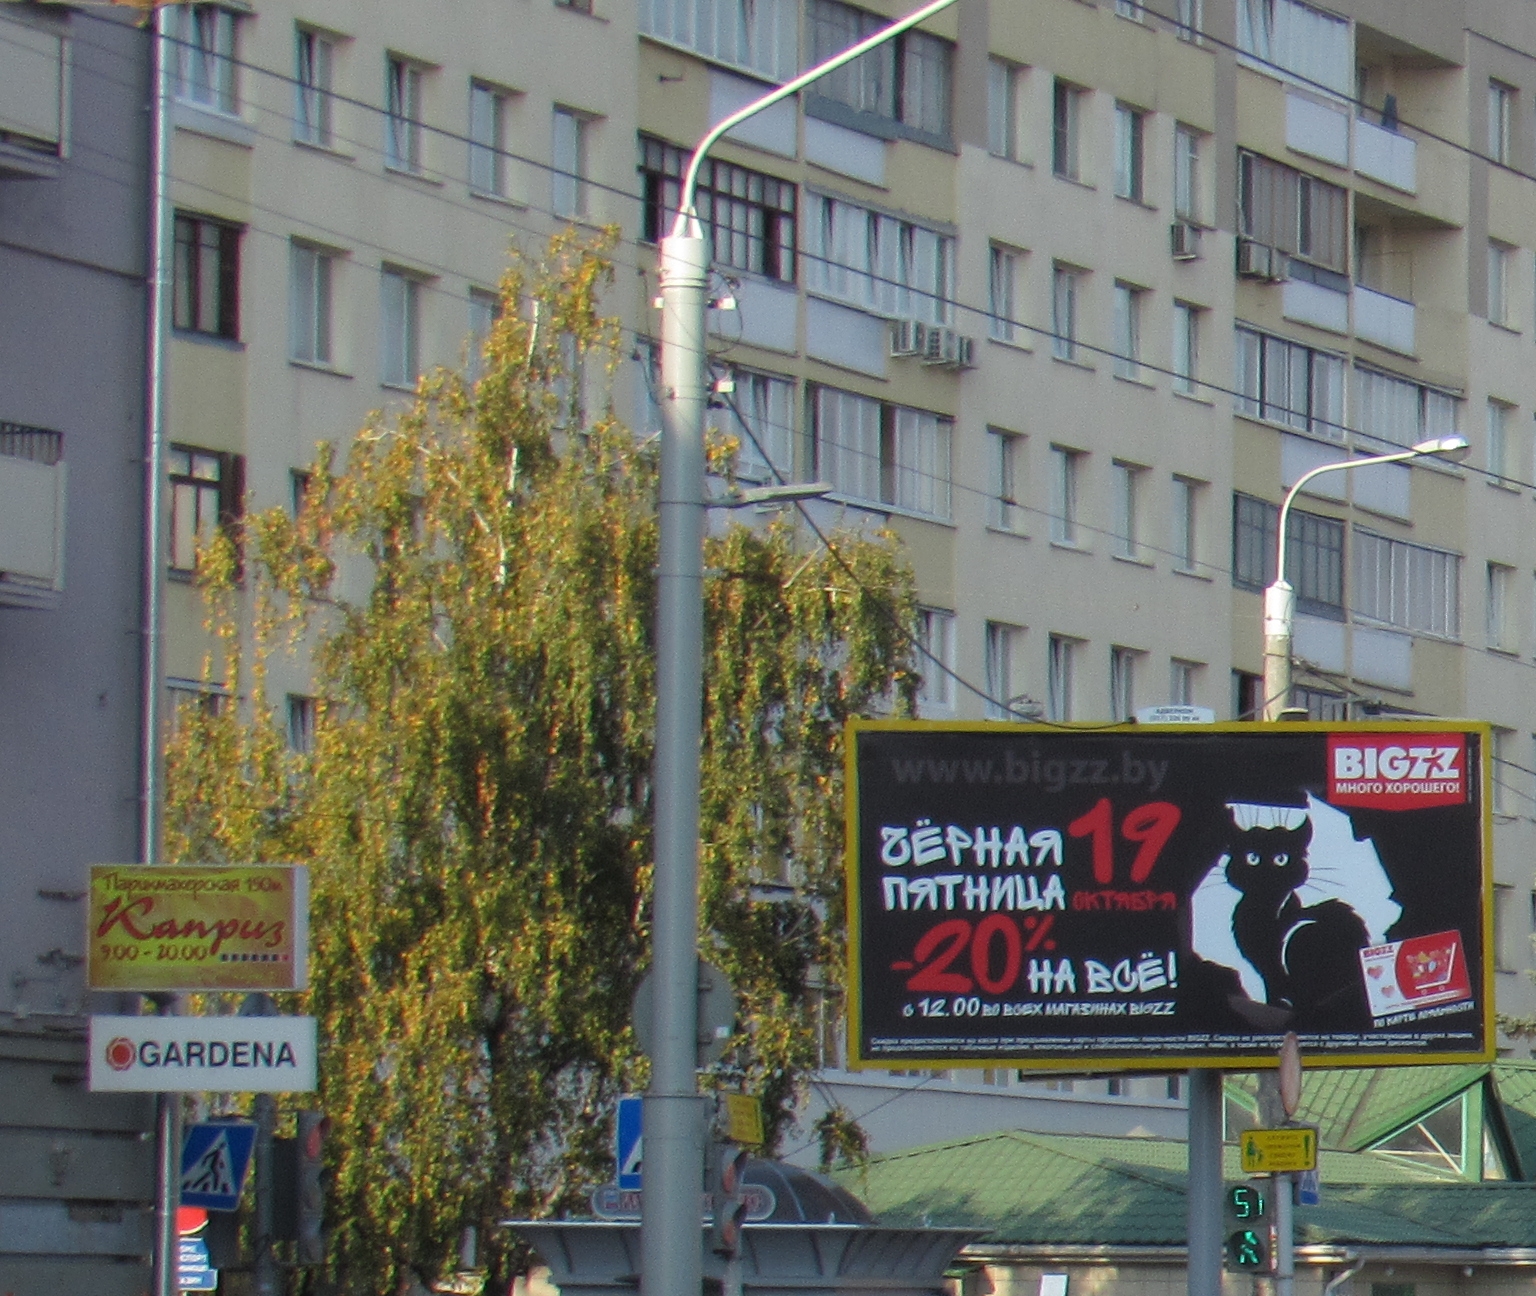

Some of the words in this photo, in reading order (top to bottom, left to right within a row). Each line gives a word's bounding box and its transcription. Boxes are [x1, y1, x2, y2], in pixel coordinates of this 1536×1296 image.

[891, 750, 1168, 792] www.bigzz.by
[1335, 746, 1460, 780] BIGZZ
[1336, 782, 1383, 794] МНОГО
[1385, 782, 1460, 794] ХОРОШЕГО!
[880, 818, 1064, 868] ЧЁРНАЯ
[1067, 797, 1182, 884] 19
[104, 872, 240, 901] Парикмахерская
[881, 873, 1066, 912] ПЯТНИЦА
[1073, 889, 1178, 911] ОКТЯБРЯ
[97, 896, 285, 955] Каприз
[890, 912, 1057, 994] -20%
[1027, 958, 1077, 995] НА
[1084, 950, 1179, 994] ВСЁ!
[918, 997, 981, 1018] 12.00
[981, 1003, 1001, 1017] ВО
[1003, 1003, 1043, 1017] ВСЕХ
[1045, 1003, 1127, 1017] МАГАЗИНАХ
[1129, 1002, 1176, 1016] BIGZZ
[138, 1040, 298, 1068] GARDENA
[1234, 1188, 1264, 1218] 51
